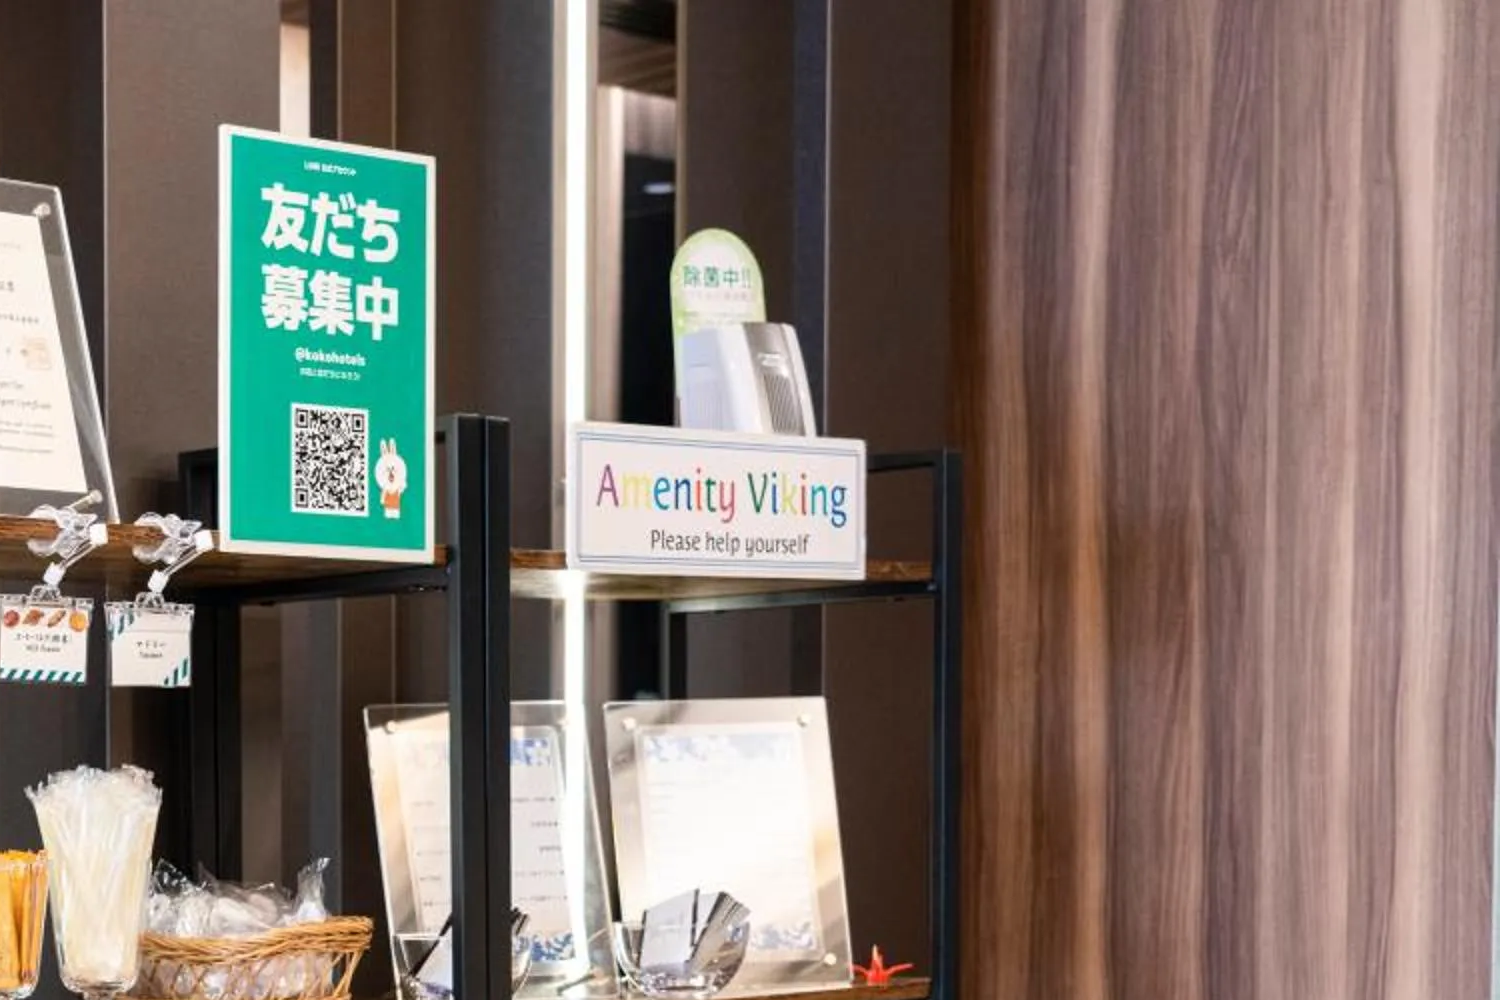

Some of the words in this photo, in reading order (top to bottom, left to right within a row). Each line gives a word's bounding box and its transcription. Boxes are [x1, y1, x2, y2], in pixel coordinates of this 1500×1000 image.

[260, 182, 400, 264] 友だち
[260, 263, 399, 341] 募集中
[597, 464, 736, 524] Amenity
[747, 472, 848, 528] Viking
[650, 529, 701, 552] Please
[705, 531, 741, 556] help
[745, 533, 811, 558] yourself
